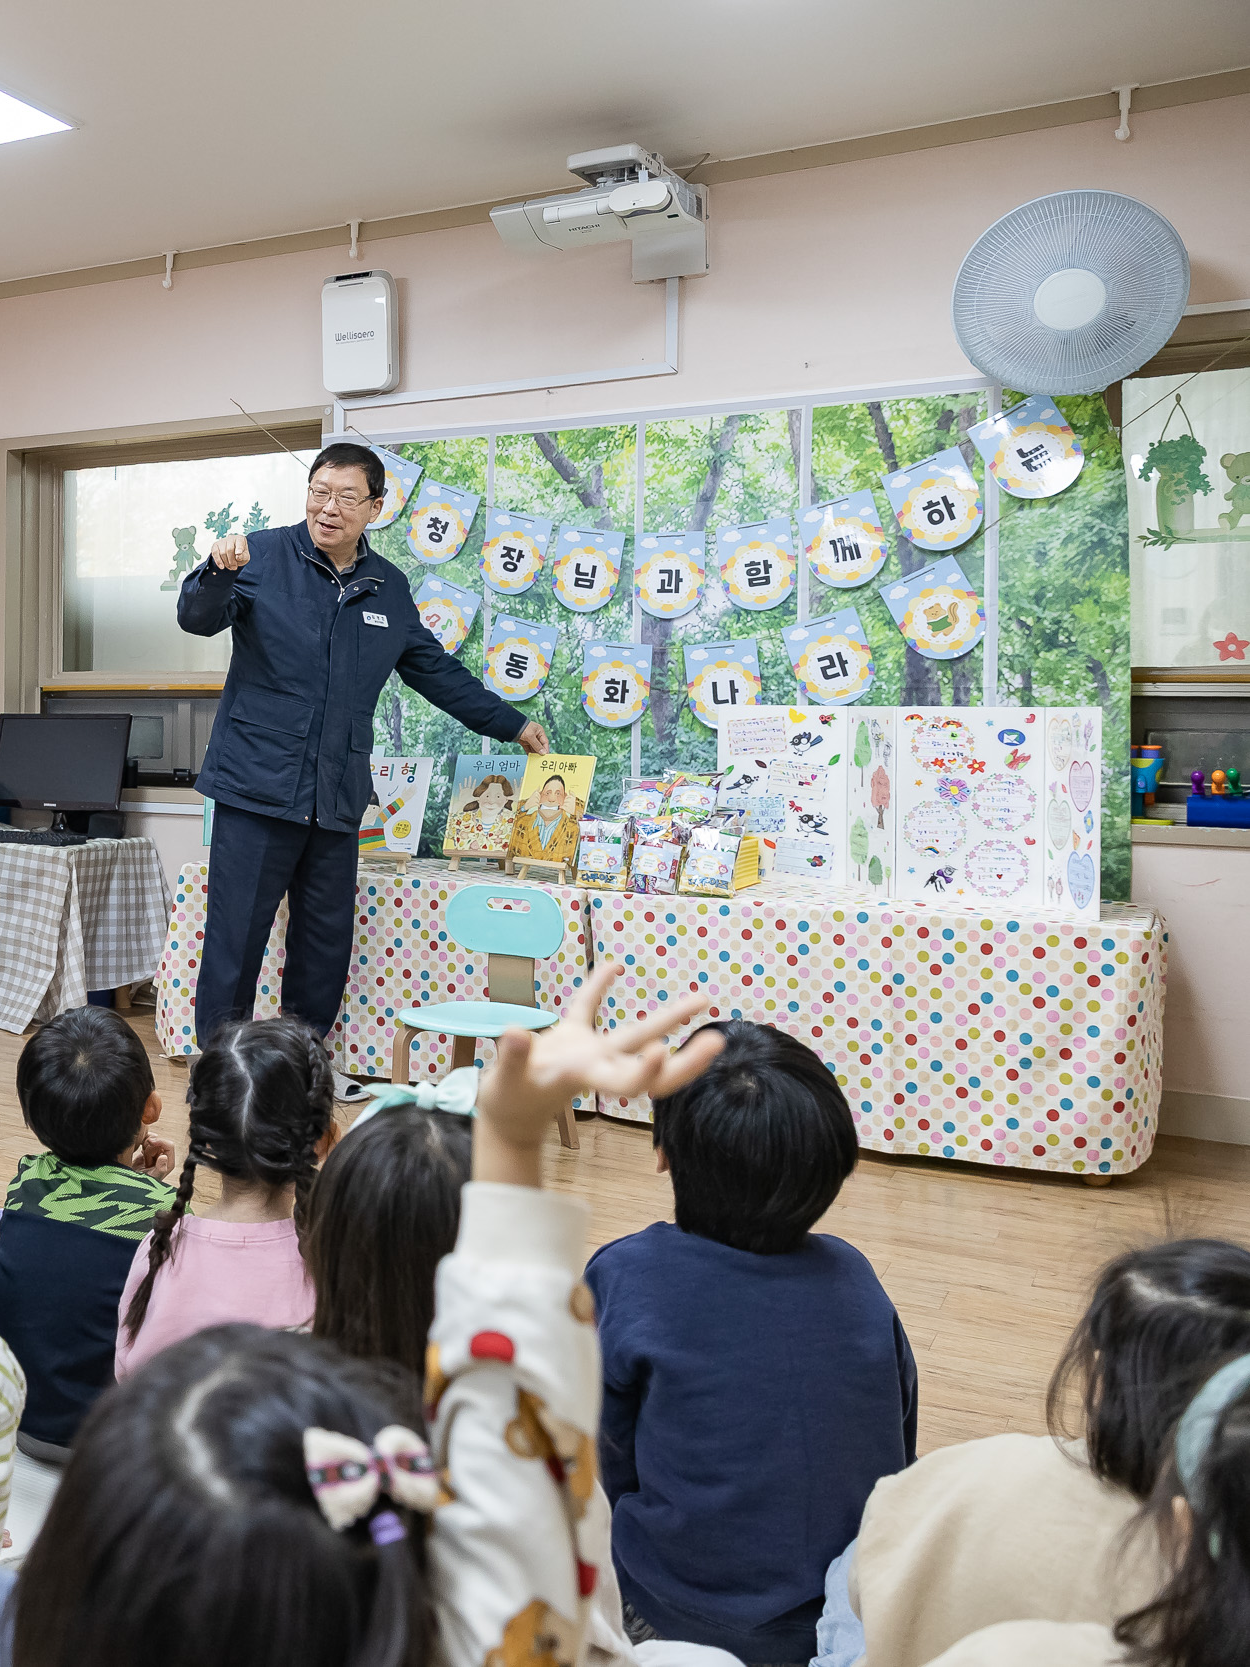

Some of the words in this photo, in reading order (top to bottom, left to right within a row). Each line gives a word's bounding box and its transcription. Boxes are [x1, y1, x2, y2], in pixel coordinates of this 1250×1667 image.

[401, 763, 417, 783] 형
[473, 760, 495, 772] 우리
[498, 760, 521, 772] 엄마
[540, 760, 558, 772] 우리
[558, 761, 578, 774] 아빠
